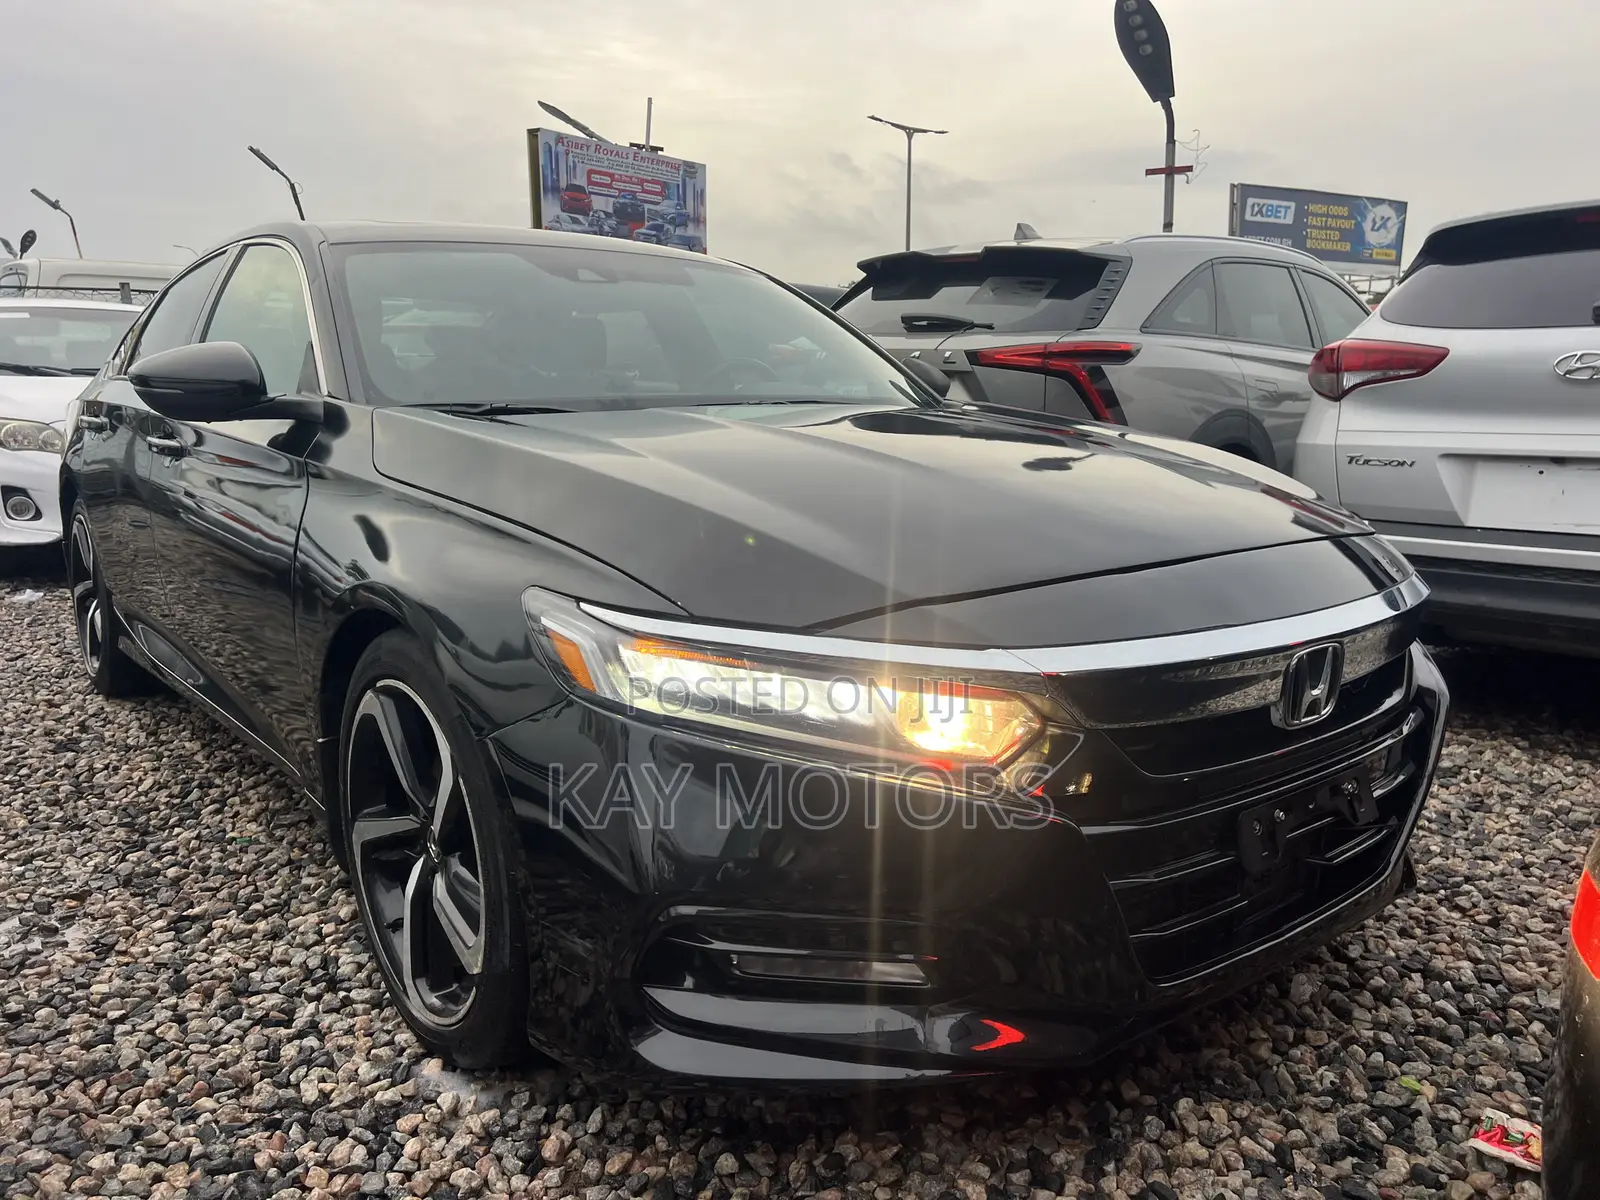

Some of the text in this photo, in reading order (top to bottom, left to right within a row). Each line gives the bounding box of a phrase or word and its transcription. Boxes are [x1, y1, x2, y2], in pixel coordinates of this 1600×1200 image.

[556, 136, 591, 152] ASIBEY
[594, 144, 630, 160] ROYALS
[633, 151, 682, 171] ENTERPRISE
[1250, 202, 1291, 220] 1XBET
[1308, 203, 1348, 217] HIGH ODDS
[1307, 216, 1356, 229] FAST PAYOUT
[1307, 229, 1340, 240] TRUSTED
[1306, 239, 1351, 252] BOOKMAKER
